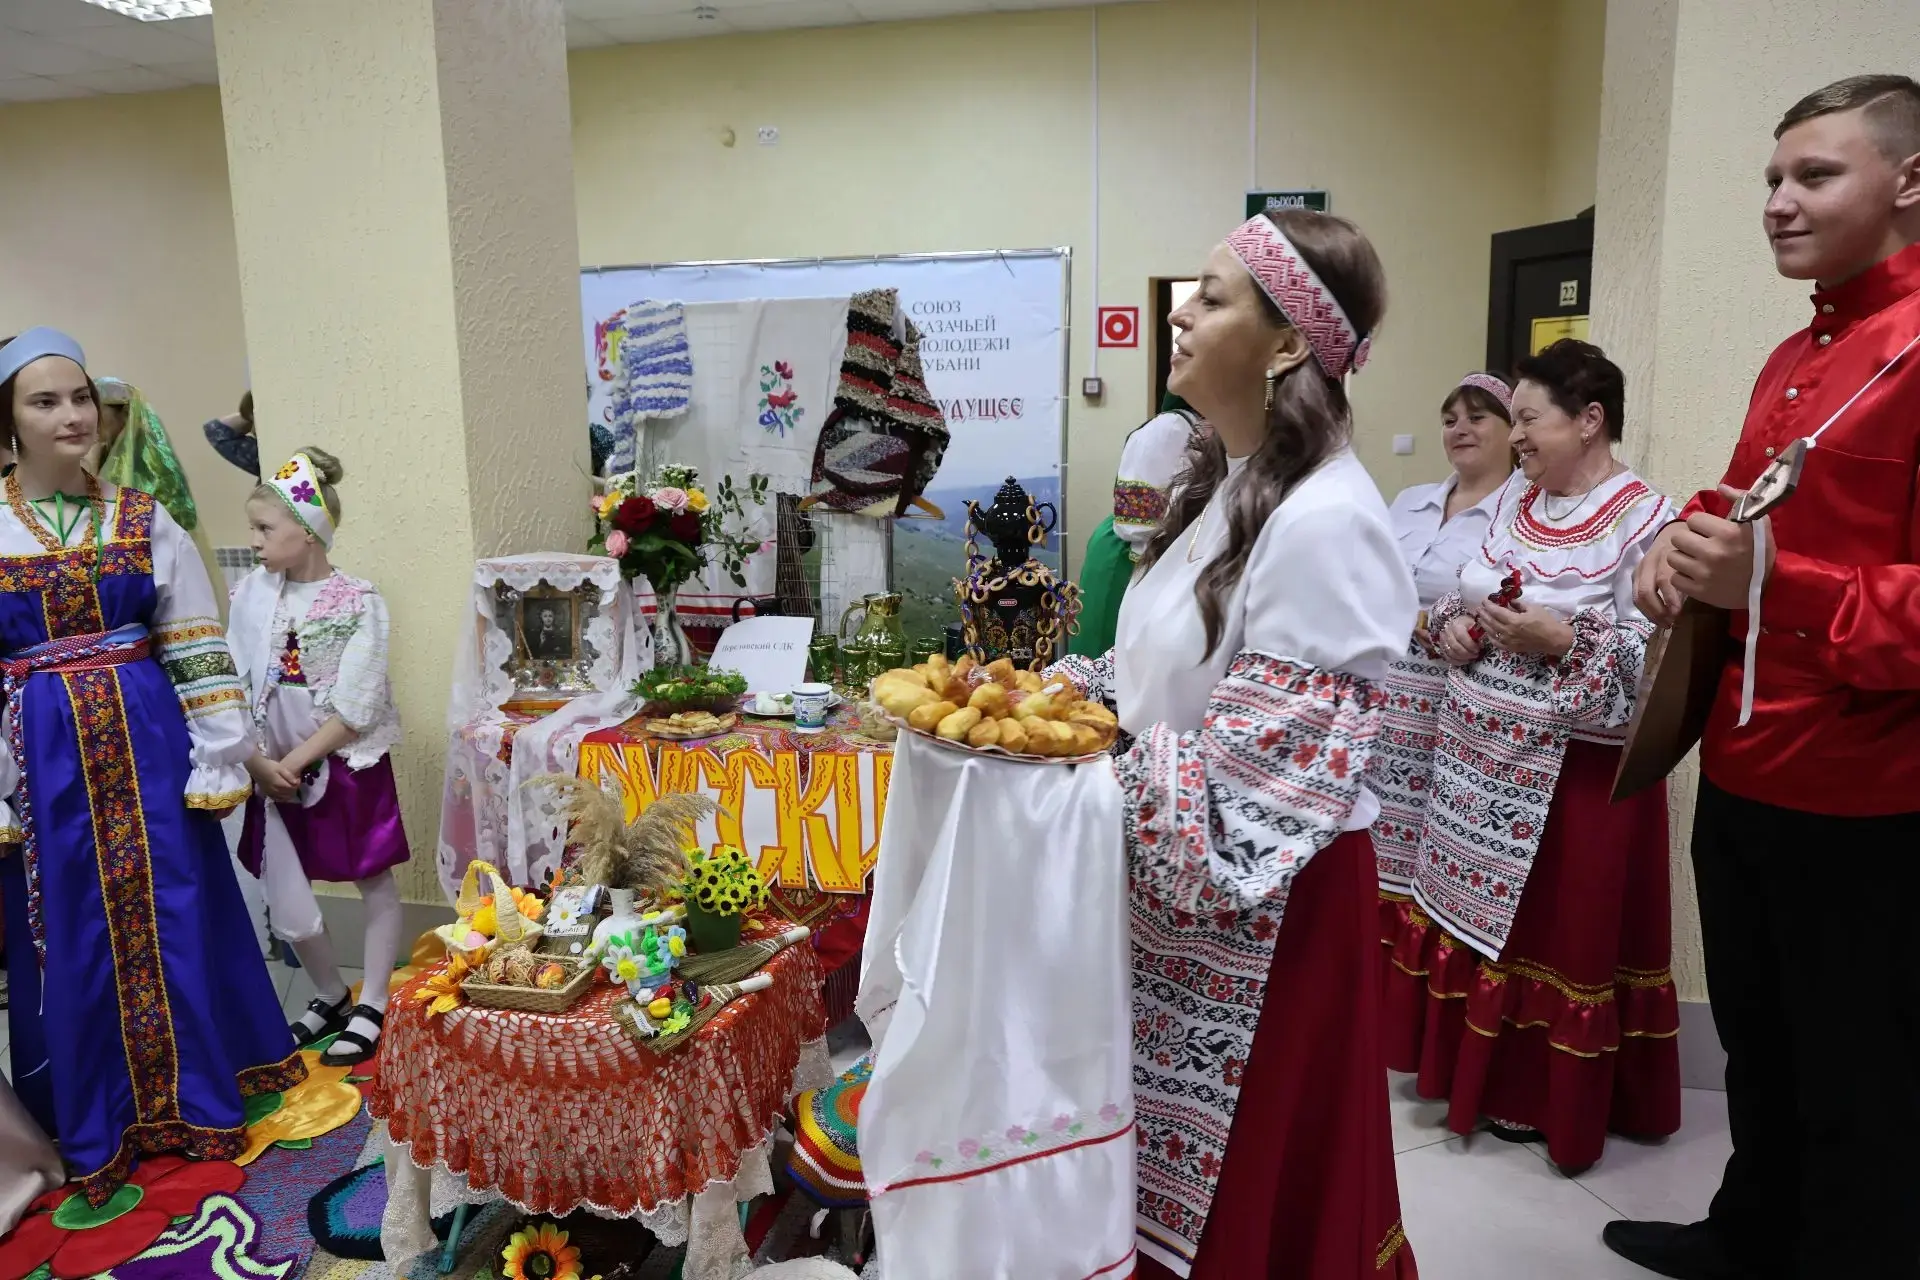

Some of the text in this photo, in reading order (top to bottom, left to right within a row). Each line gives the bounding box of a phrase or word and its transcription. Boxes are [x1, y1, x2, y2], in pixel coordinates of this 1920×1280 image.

[1266, 195, 1305, 209] ВЫХОД
[1562, 285, 1575, 302] 22
[912, 300, 961, 315] СОЮЗ
[922, 357, 981, 372] УБАНИ
[938, 398, 1022, 420] УДУЩЕЕ
[578, 742, 894, 890] РУССКИ
